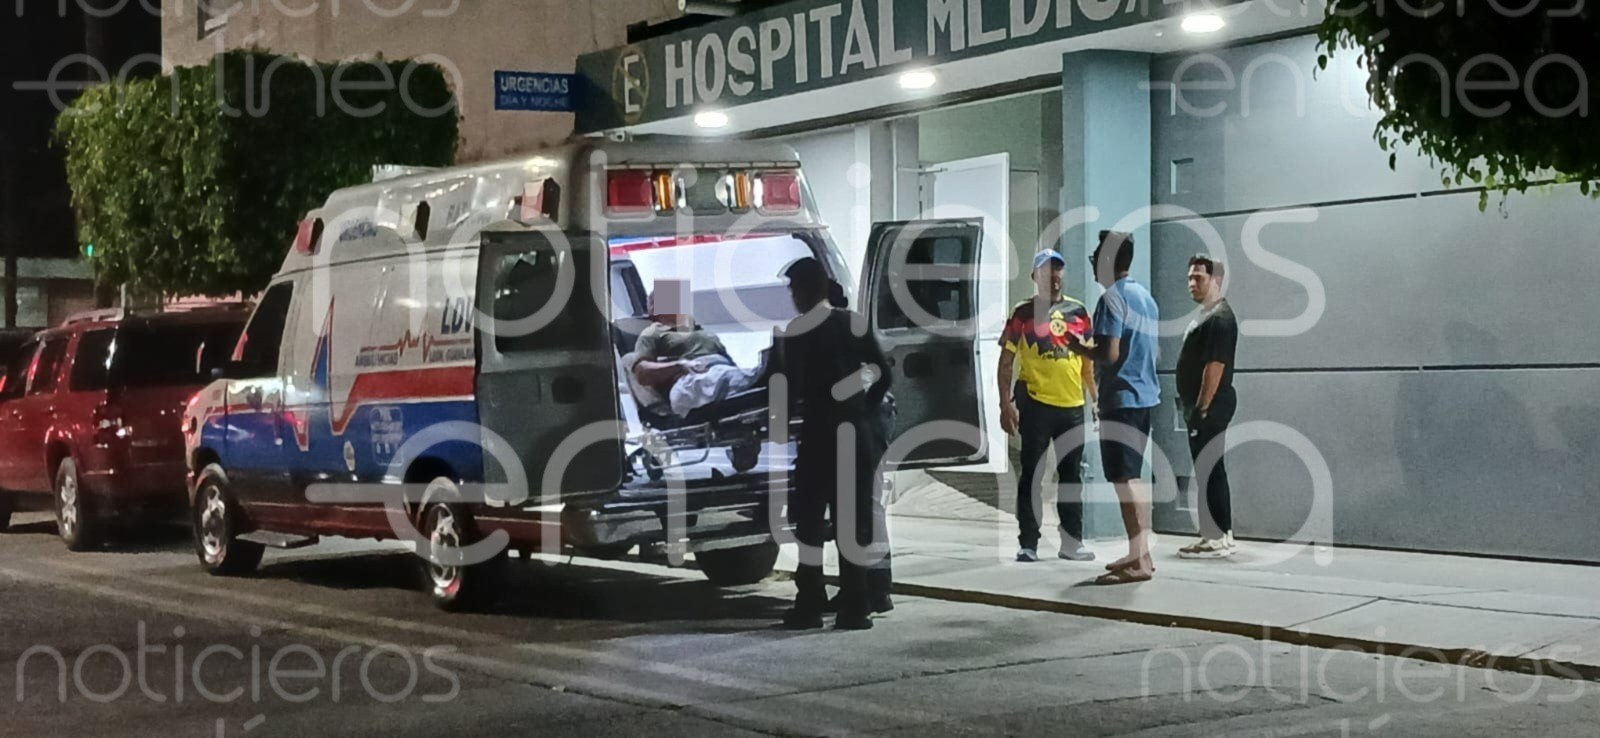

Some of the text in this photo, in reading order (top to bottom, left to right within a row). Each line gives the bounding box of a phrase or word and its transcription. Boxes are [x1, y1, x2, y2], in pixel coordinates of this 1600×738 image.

[500, 76, 568, 93] URGENCIAS
[664, 0, 1182, 110] HOSPITAL MED
